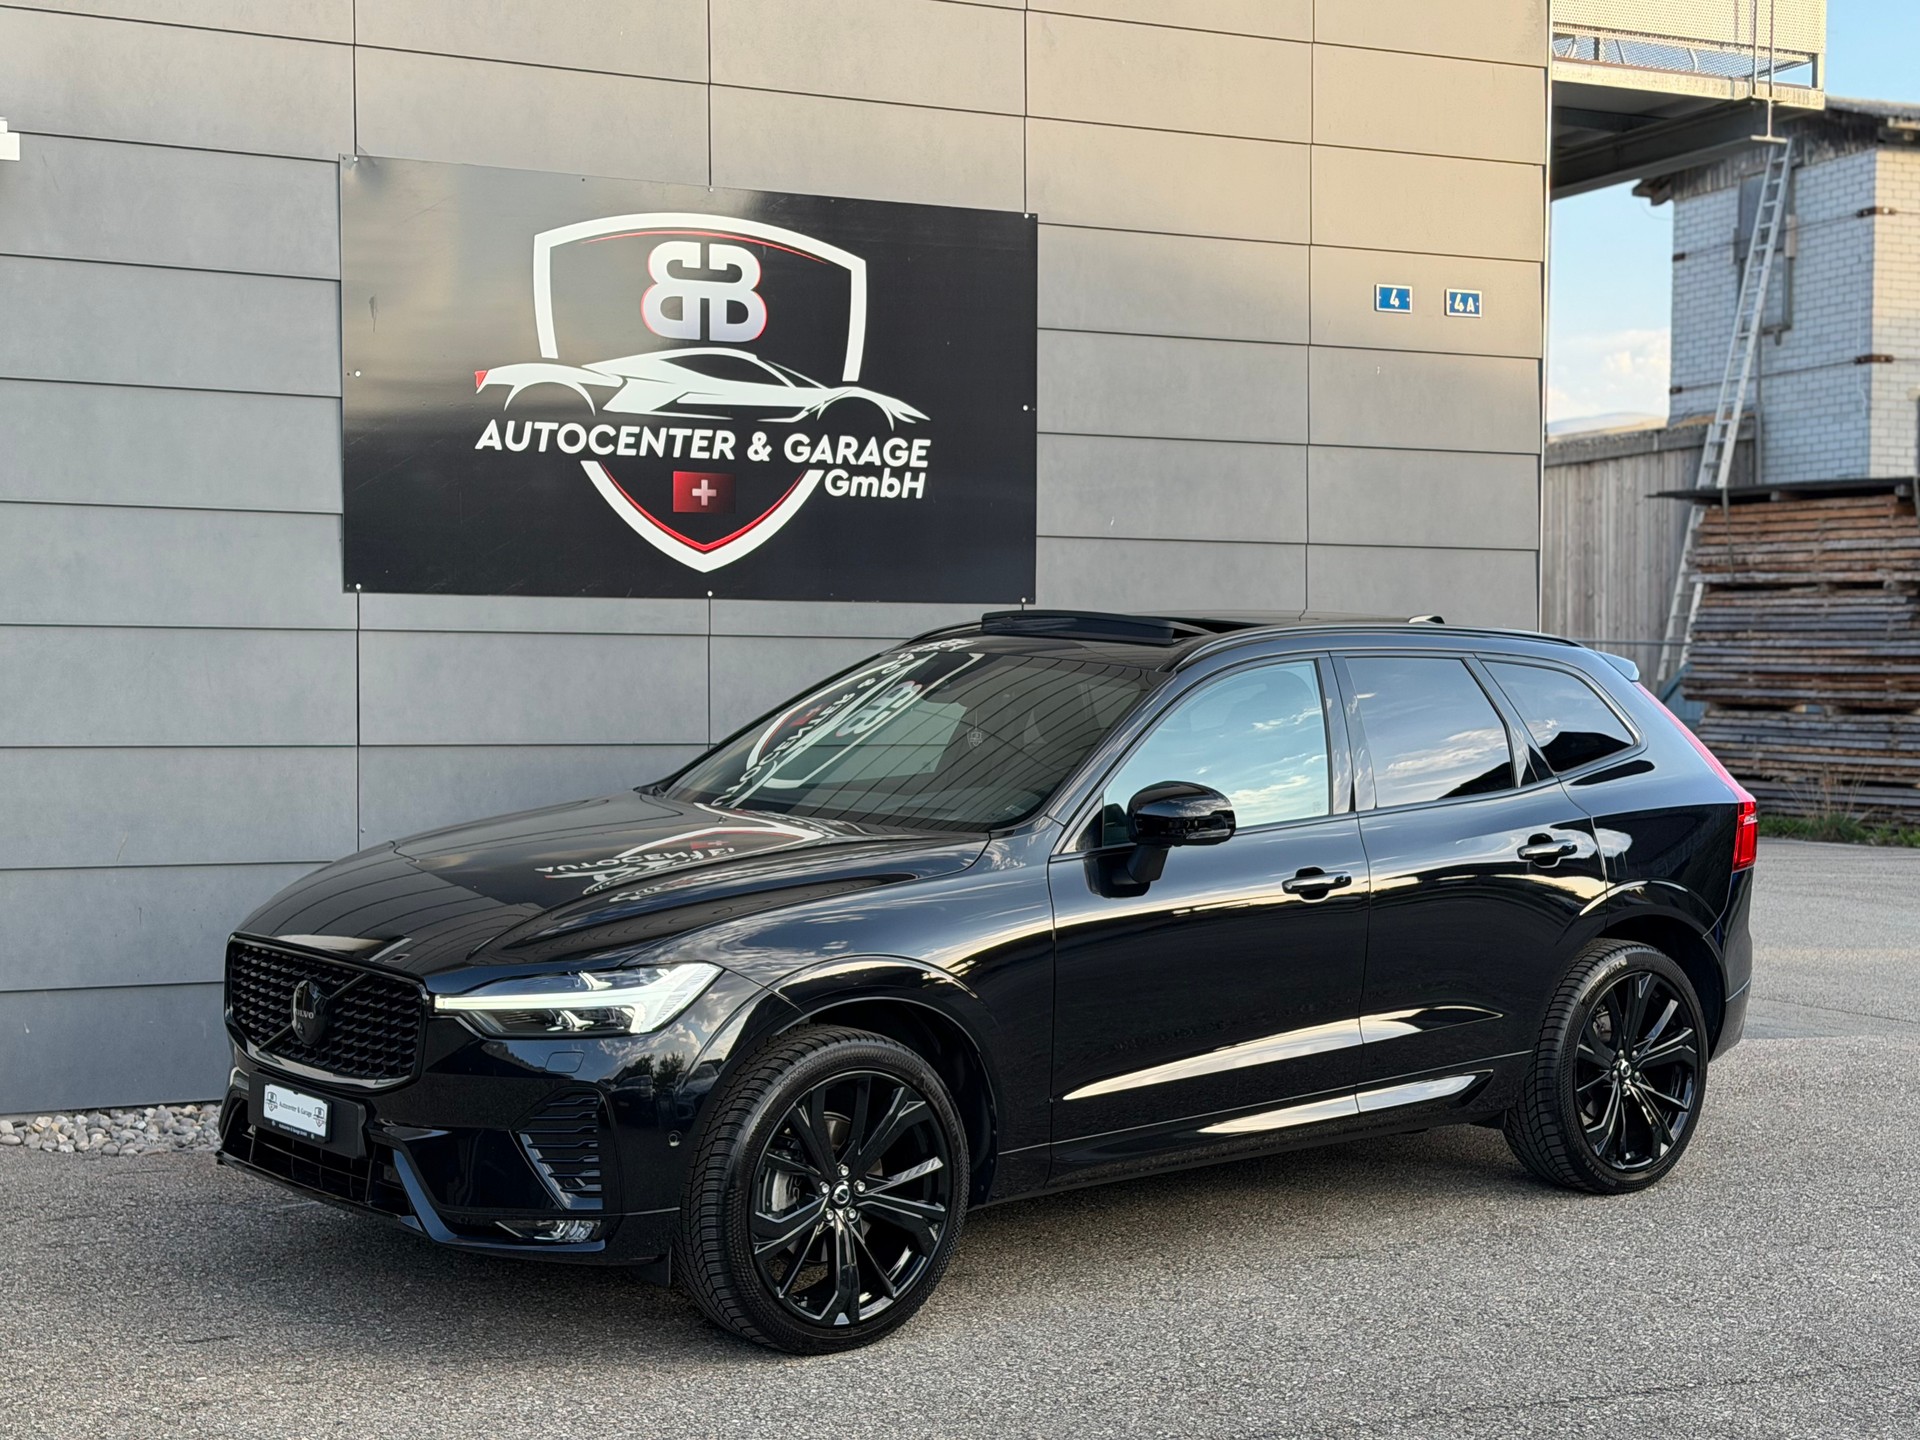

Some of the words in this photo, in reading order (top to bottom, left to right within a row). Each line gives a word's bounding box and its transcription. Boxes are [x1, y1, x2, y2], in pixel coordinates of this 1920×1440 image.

[1389, 288, 1400, 308] 4
[1453, 293, 1475, 313] 4A
[474, 418, 736, 460] AUTOCENTER
[747, 431, 773, 462] &
[784, 433, 931, 468] GARAGE
[824, 469, 926, 499] GmbH
